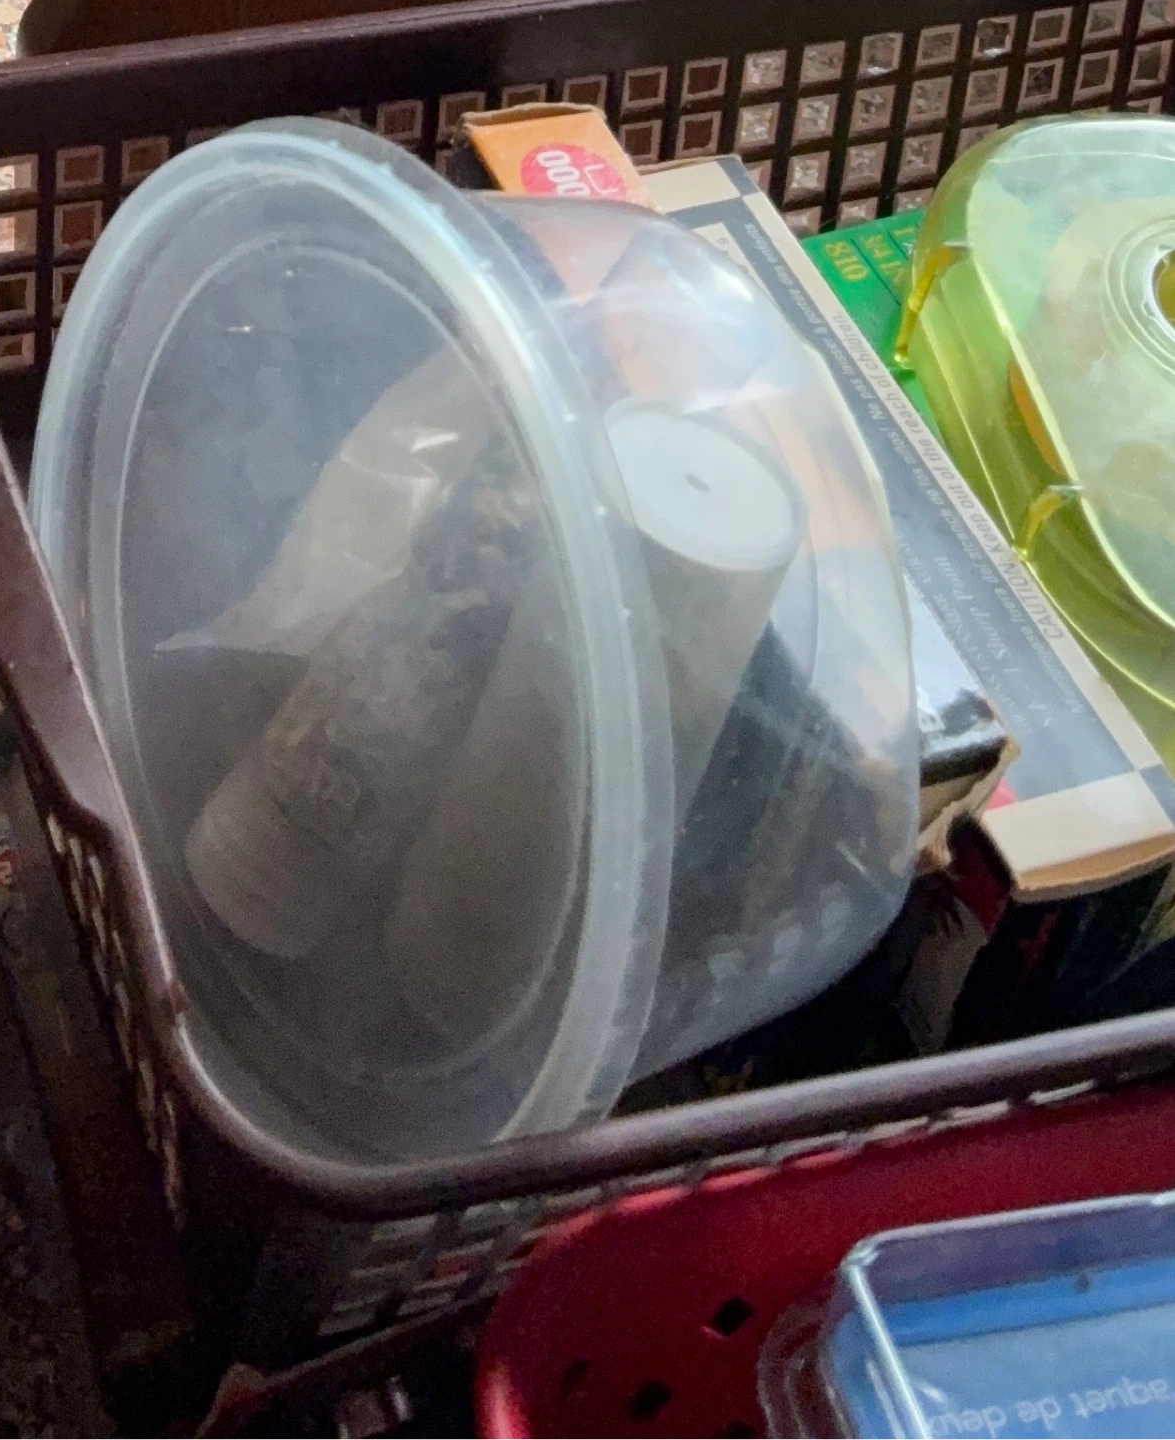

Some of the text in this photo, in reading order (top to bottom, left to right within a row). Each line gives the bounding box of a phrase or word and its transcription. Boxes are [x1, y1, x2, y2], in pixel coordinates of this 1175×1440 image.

[533, 148, 593, 196] 000
[868, 373, 891, 388] of
[882, 390, 923, 433] reach
[916, 436, 942, 462] the
[931, 464, 955, 480] of
[946, 482, 974, 509] out
[966, 515, 1004, 554] Keep
[1014, 1394, 1062, 1431] de
[1068, 1376, 1170, 1421] aquet
